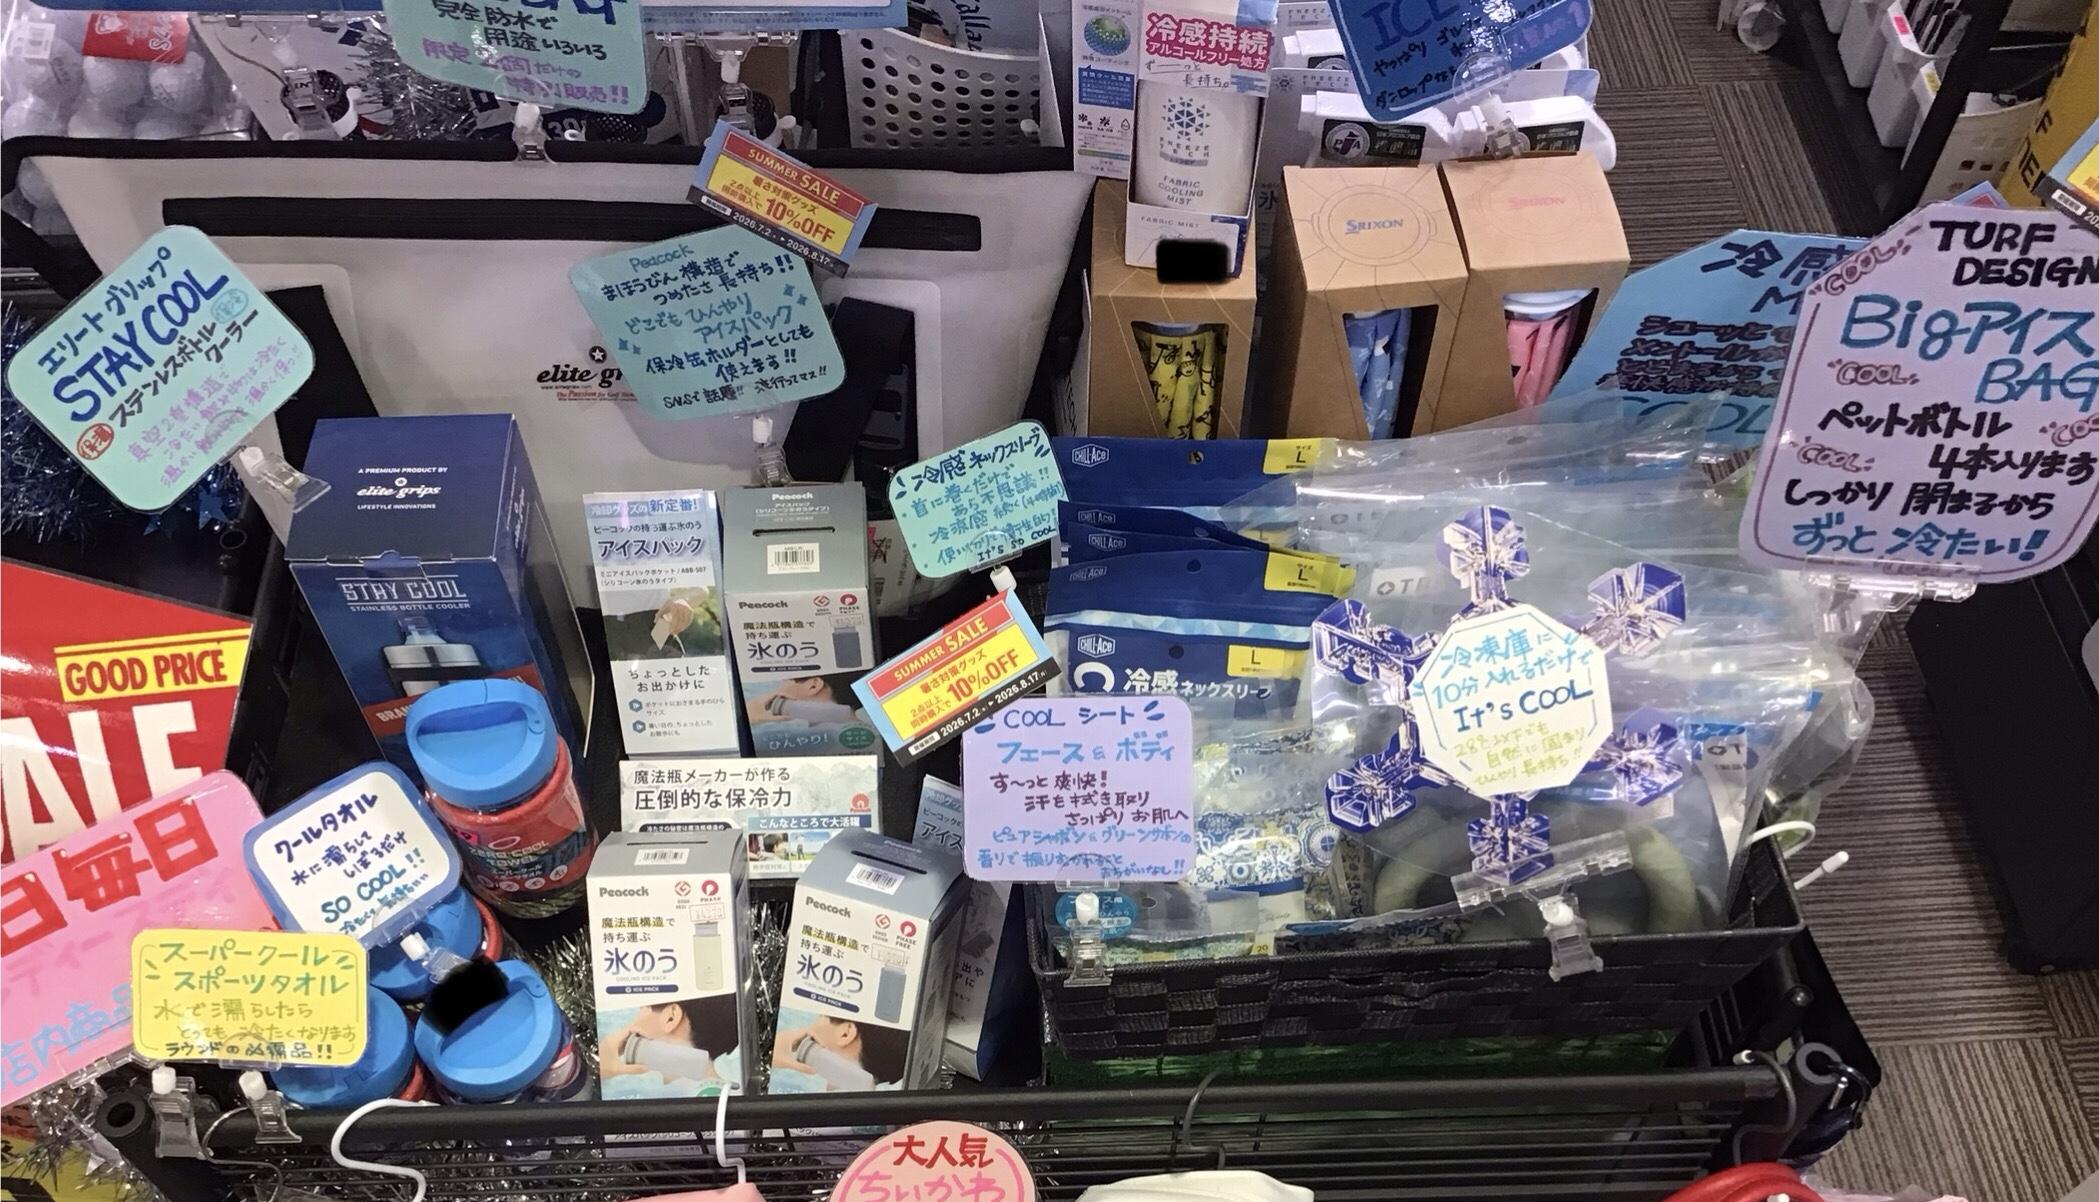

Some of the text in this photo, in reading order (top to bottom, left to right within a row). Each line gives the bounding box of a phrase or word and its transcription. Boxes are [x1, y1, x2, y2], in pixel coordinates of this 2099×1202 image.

[484, 27, 608, 61] 用途いろいろ
[1149, 14, 1270, 55] 冷感持続
[1148, 42, 1267, 69] アルコールフリー処方
[748, 149, 841, 204] SUMMER SALE
[1158, 184, 1204, 197] COOLING
[1163, 175, 1201, 188] FABRIC
[1166, 194, 1193, 206] MIST
[765, 197, 836, 244] 10%OFF
[1345, 218, 1404, 235] SRIXON
[1930, 220, 2057, 256] TURF
[629, 243, 695, 272] Peacock
[1953, 256, 2099, 288] DESIGN
[601, 250, 740, 302] まほうびん 構造で
[653, 278, 714, 306] つめたさ
[625, 291, 753, 335] どこでも ひんやり
[693, 304, 793, 345] アイスパック
[53, 269, 230, 422] STAY COOL
[108, 321, 217, 428] ステンレスボトル
[536, 363, 598, 384] elite
[1836, 361, 1911, 386] COOL
[1974, 357, 2099, 413] BAG
[1818, 401, 2013, 438] ペットボトル
[365, 467, 401, 475] PREMIUM
[401, 466, 437, 474] PRODUCT
[438, 466, 448, 474] BY
[911, 426, 1041, 492] 冷感 ネックスリーブ
[1296, 450, 1307, 463] L
[1928, 443, 2098, 486] 4本入ります
[356, 484, 441, 499] elite grips
[772, 491, 813, 501] Peacock
[1785, 479, 2056, 521] しっかり 閉まるから
[357, 503, 392, 511] LIFESTYLE
[597, 536, 703, 558] アイスパック
[1792, 511, 2051, 562] ずっと 冷たい!
[1298, 568, 1309, 581] L
[341, 579, 467, 601] STAY COOL
[738, 600, 789, 610] Peacock
[747, 641, 820, 661] 氷のう
[893, 616, 989, 682] SUMMER SALE
[1251, 650, 1261, 665] L
[1441, 628, 1553, 679] 冷凍庫に
[65, 649, 228, 696] GOOD PRICE
[628, 665, 711, 679] ちょっとした
[920, 648, 988, 694] 暑さ対策グッズ
[946, 648, 1020, 703] 10%OFF
[1432, 648, 1594, 710] 10分 入れるだけで
[637, 680, 705, 692] お出かけに
[910, 695, 943, 717] 2点以上
[910, 700, 952, 730] 同時購入で
[1004, 706, 1135, 729] COOL シート
[1454, 679, 1594, 733] It's COOL
[997, 741, 1085, 764] フェース
[1115, 731, 1175, 762] ボディ
[634, 767, 791, 784] 魔法瓶メーカーが作る
[634, 787, 792, 811] 圧倒的な保冷力
[274, 793, 378, 863] クールタオル
[759, 817, 860, 828] こんなところで大活躍
[1065, 807, 1189, 826] さっぱり お肌へ
[343, 831, 409, 879] しぼるだけ
[321, 864, 406, 924] SO COOL
[599, 886, 649, 898] Peacock
[805, 896, 851, 919] Peacock
[602, 916, 676, 929] 魔法瓶構造で
[159, 938, 330, 967] スーパークール
[603, 932, 652, 944] 持ち運ぶ
[800, 938, 844, 959] 持ち運ぶ
[802, 924, 869, 953] 魔法瓶構造で
[604, 947, 678, 975] 氷のう
[796, 954, 863, 994] 氷のう
[174, 965, 350, 996] スポーツタオル
[893, 1133, 994, 1169] 大人気
